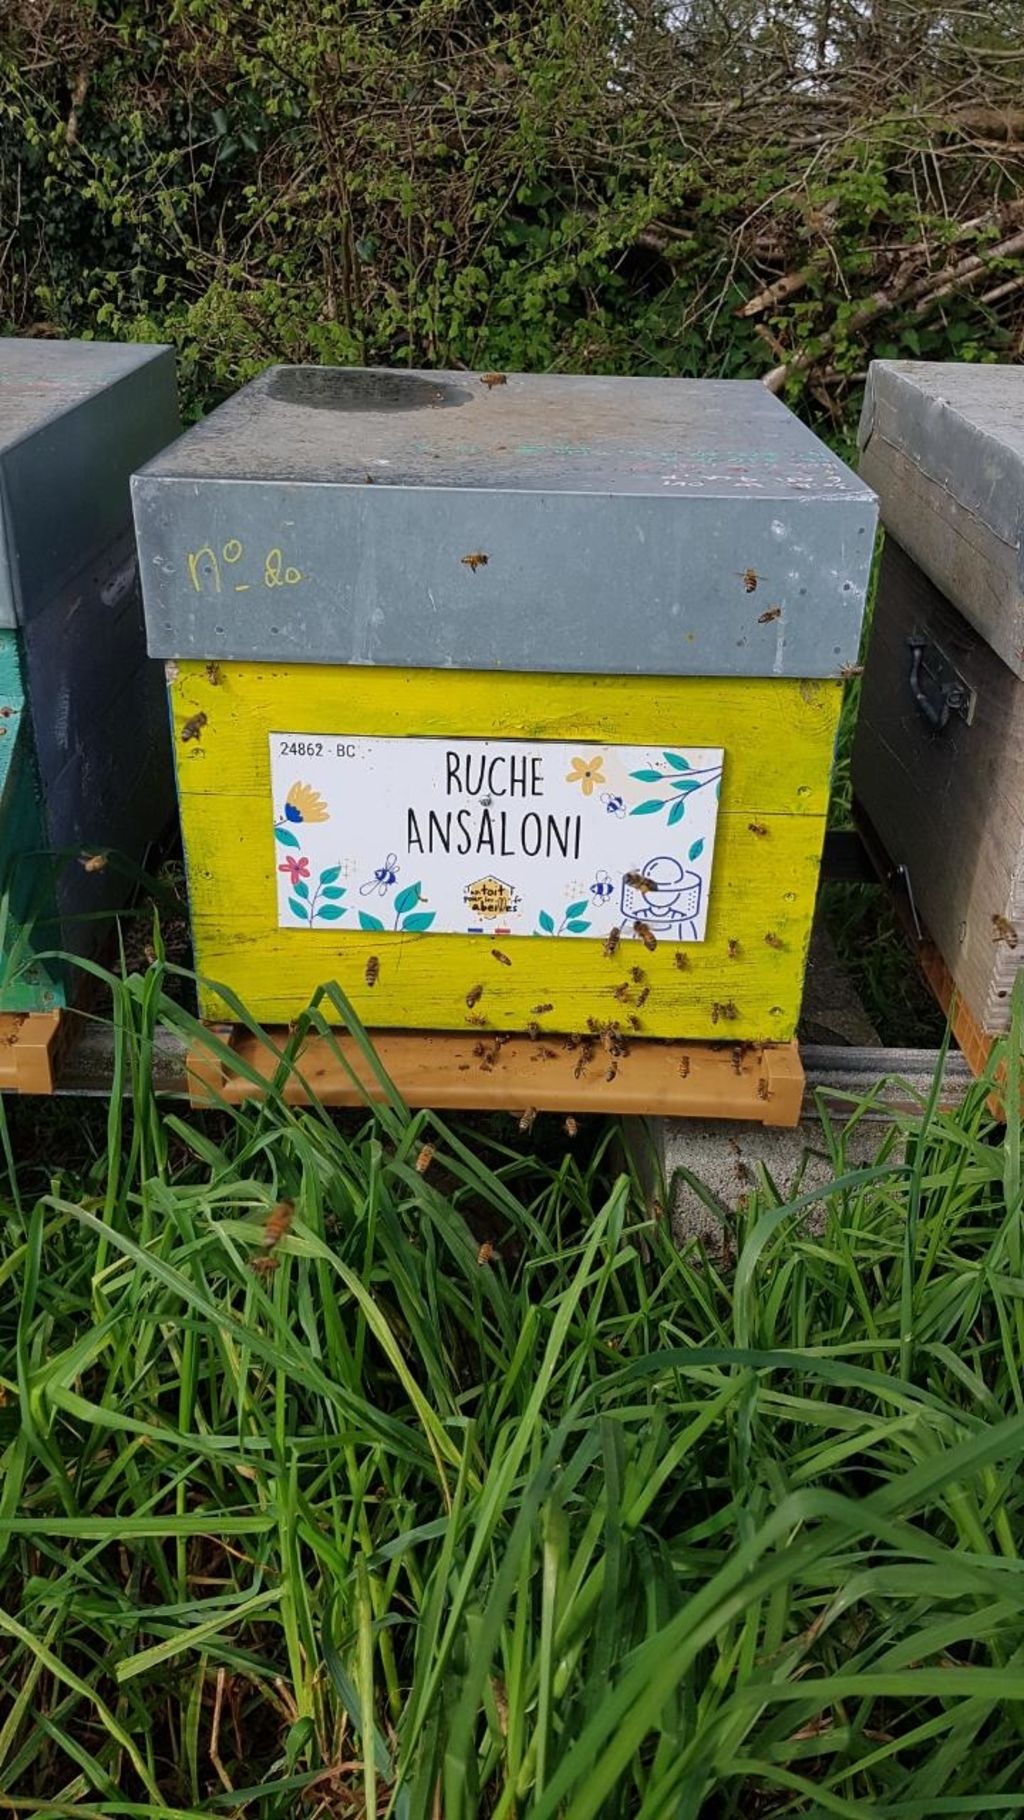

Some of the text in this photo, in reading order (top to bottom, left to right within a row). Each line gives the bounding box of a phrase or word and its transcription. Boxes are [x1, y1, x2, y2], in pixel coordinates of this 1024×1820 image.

[280, 741, 324, 757] 24862
[336, 743, 356, 758] BC
[446, 751, 544, 798] RUCHE
[407, 807, 581, 859] ANSALONI
[481, 884, 506, 896] toit
[471, 898, 518, 912] abeilles
